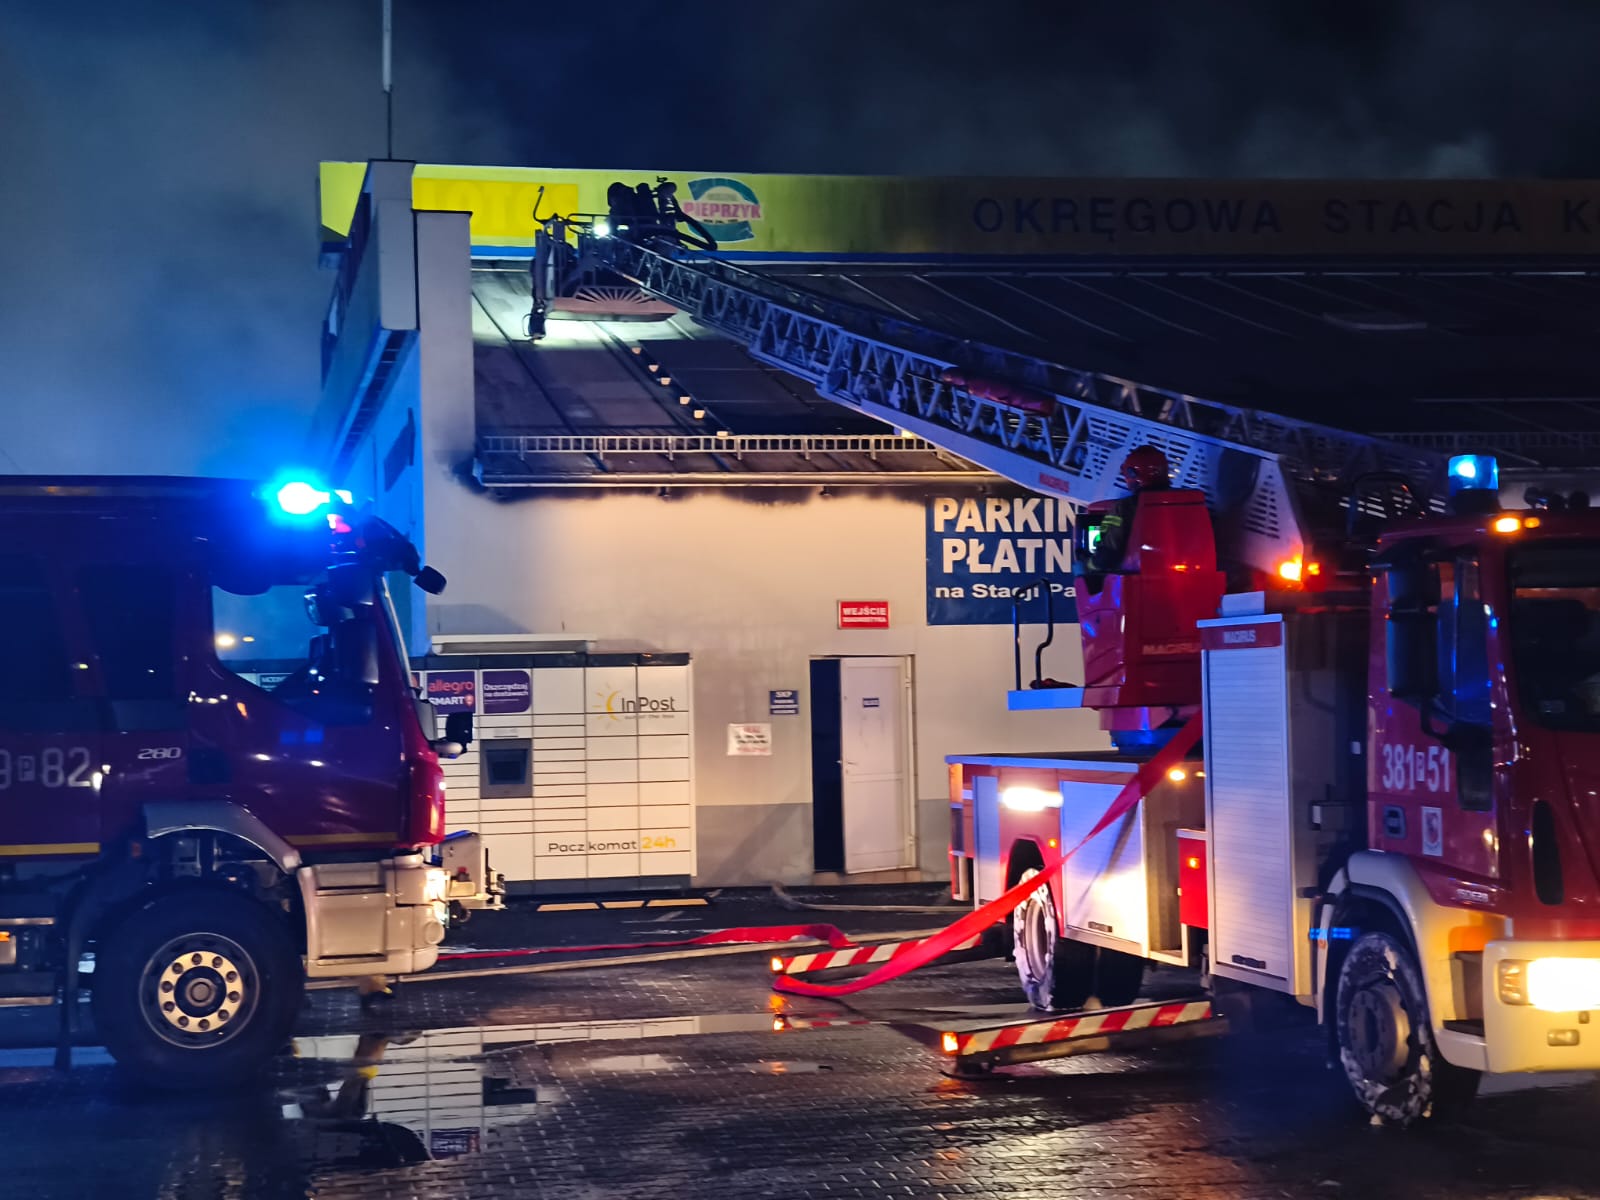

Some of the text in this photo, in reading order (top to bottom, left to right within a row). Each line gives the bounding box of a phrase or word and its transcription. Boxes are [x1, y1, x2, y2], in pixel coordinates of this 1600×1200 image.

[683, 201, 761, 219] PIEPRZYK
[972, 197, 1600, 241] OKRĘGOWA STACJA K
[934, 498, 1076, 533] PARKIN
[942, 539, 1072, 573] PŁATN
[935, 587, 964, 598] na
[1050, 583, 1077, 598] Pa
[842, 606, 887, 616] WEJŚCIE
[428, 680, 474, 695] allegro
[429, 696, 464, 706] SMART
[621, 696, 675, 712] InPost
[137, 747, 182, 760] 280
[641, 835, 676, 850] 24h
